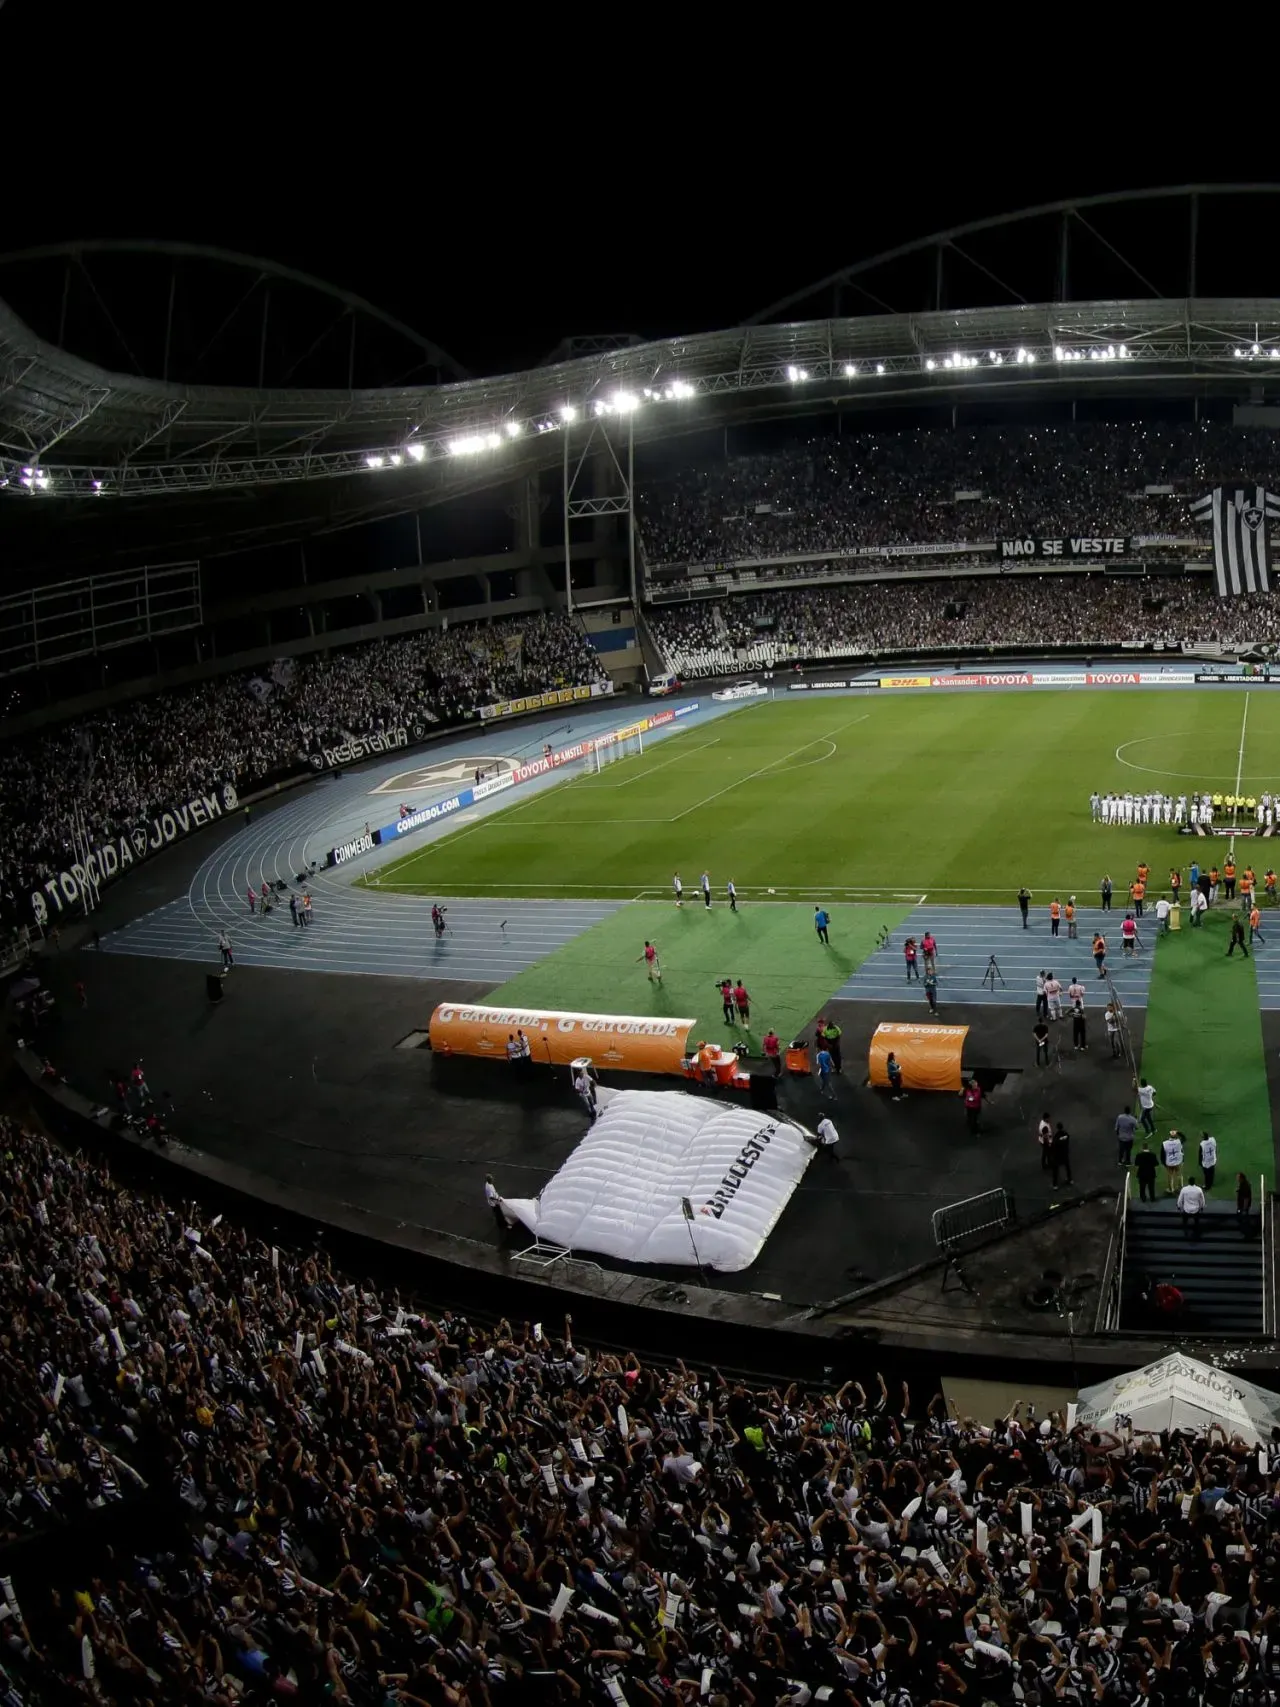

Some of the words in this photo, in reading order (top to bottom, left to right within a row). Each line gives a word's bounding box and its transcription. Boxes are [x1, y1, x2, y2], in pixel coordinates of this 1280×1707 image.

[1042, 540, 1063, 555] SE
[1070, 538, 1125, 553] VESTE
[691, 660, 763, 679] ALVINEGROS
[891, 679, 920, 687] DHL
[940, 676, 978, 687] Santander
[985, 675, 1028, 685] TOYOTA
[1091, 674, 1136, 684] TOYOTA
[560, 744, 584, 763] AMSTEL
[515, 758, 550, 781] TOYOTA
[397, 797, 460, 833] CONMEBOL.COM
[45, 835, 133, 912] TORCIDA
[150, 791, 222, 849] JOVEM
[334, 833, 376, 865] CONMEBOL
[459, 1009, 540, 1028] GATORADE
[582, 1019, 678, 1036] GATORADE
[896, 1026, 965, 1035] GATORADE
